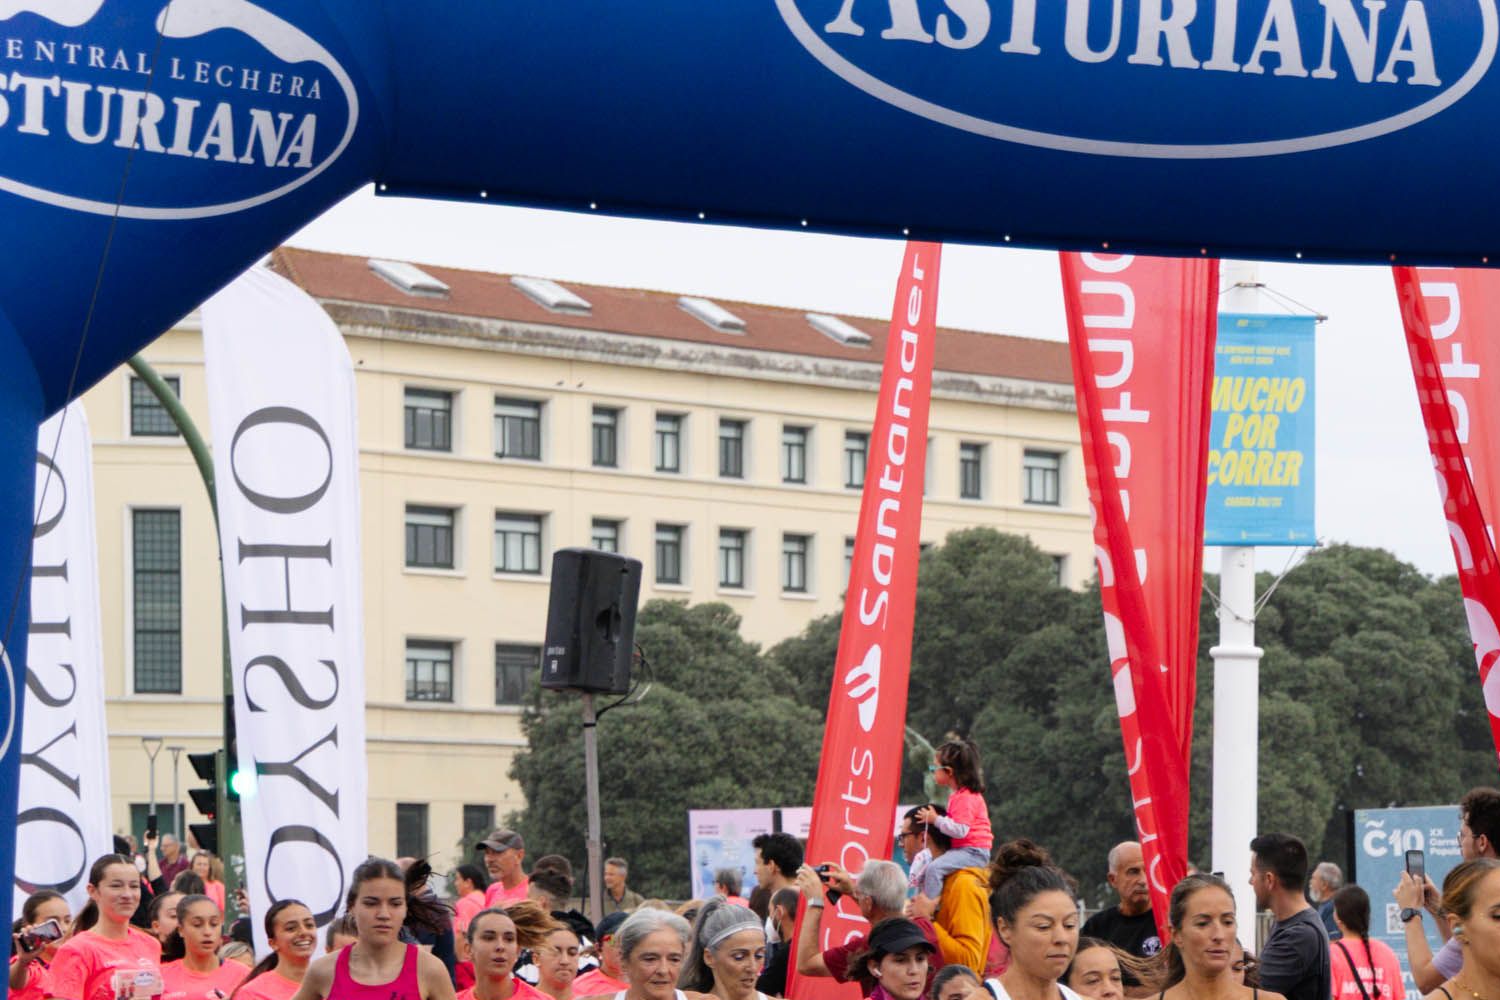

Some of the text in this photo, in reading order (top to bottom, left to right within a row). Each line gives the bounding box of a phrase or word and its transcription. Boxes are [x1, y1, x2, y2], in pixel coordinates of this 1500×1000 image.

[5, 38, 321, 100] ENTRAL LECHERA
[825, 0, 1442, 86] STURIANA
[860, 252, 926, 630] Santander
[1223, 413, 1280, 449] POR
